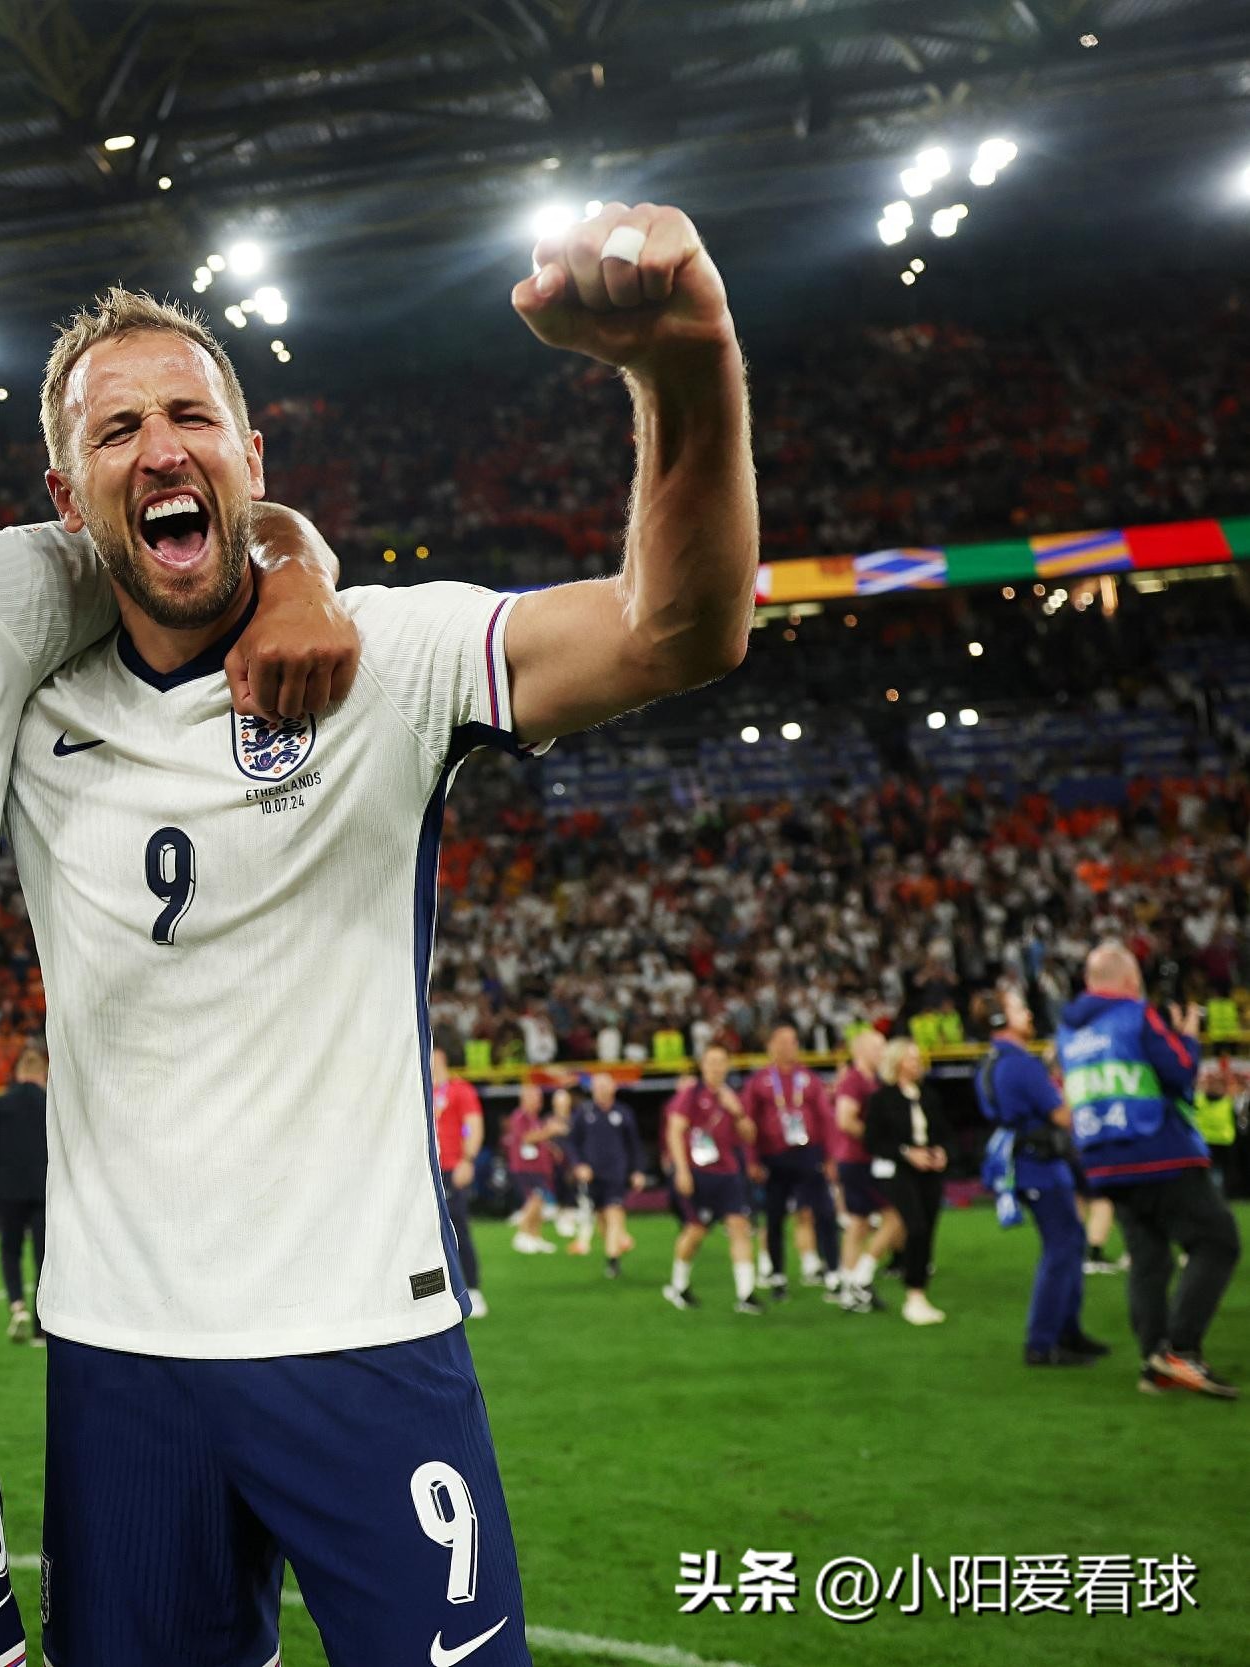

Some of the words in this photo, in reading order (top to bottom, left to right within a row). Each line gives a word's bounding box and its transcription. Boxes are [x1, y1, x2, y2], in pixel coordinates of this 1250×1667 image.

[246, 772, 322, 801] ETHERLANDS
[260, 795, 305, 815] 10.07.24
[145, 827, 196, 945] 9
[410, 1461, 478, 1604] 9
